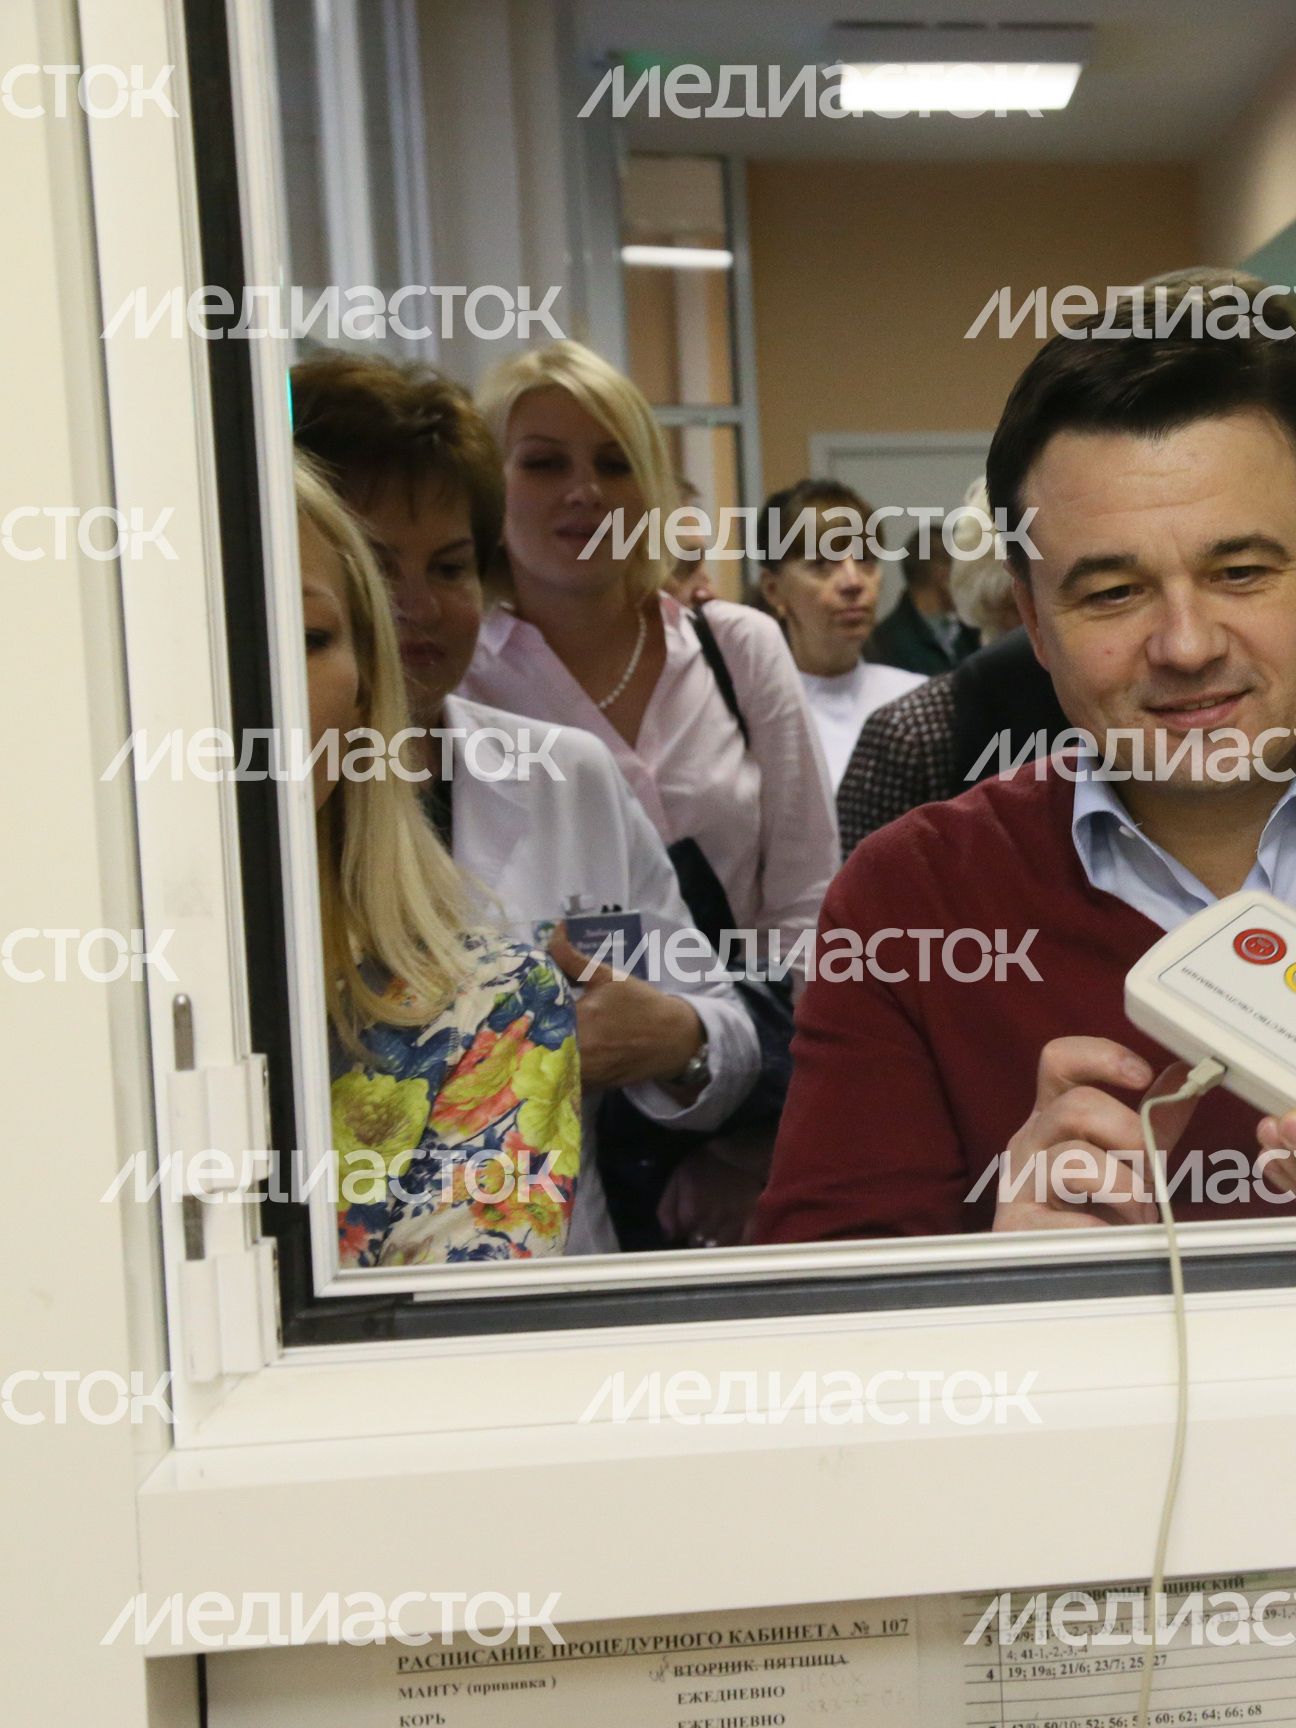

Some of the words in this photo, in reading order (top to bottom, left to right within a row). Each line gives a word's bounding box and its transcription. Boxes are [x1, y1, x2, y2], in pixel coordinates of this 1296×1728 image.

[397, 1644, 546, 1671] РАСПИСАНИЕ
[551, 1629, 724, 1659] ПРОЦЕДУРНОГО
[729, 1622, 841, 1647] КАБИНЕТА
[849, 1620, 870, 1635] №
[879, 1617, 910, 1634] 107
[984, 1634, 993, 1648] 3
[986, 1668, 995, 1682] 4
[1008, 1666, 1027, 1680] 19;
[1060, 1662, 1091, 1676] 21/6;
[1094, 1658, 1125, 1673] 23/7;
[1152, 1654, 1167, 1667] 27
[398, 1682, 464, 1701] МАНТУ
[678, 1685, 786, 1705] ЕЖЕДНЕВНО
[399, 1712, 446, 1728] КОРЬ
[1155, 1712, 1174, 1726] 60;
[1178, 1710, 1197, 1724] 62;
[1201, 1708, 1221, 1722] 64;
[1224, 1706, 1244, 1720] 66;
[1247, 1704, 1263, 1717] 68
